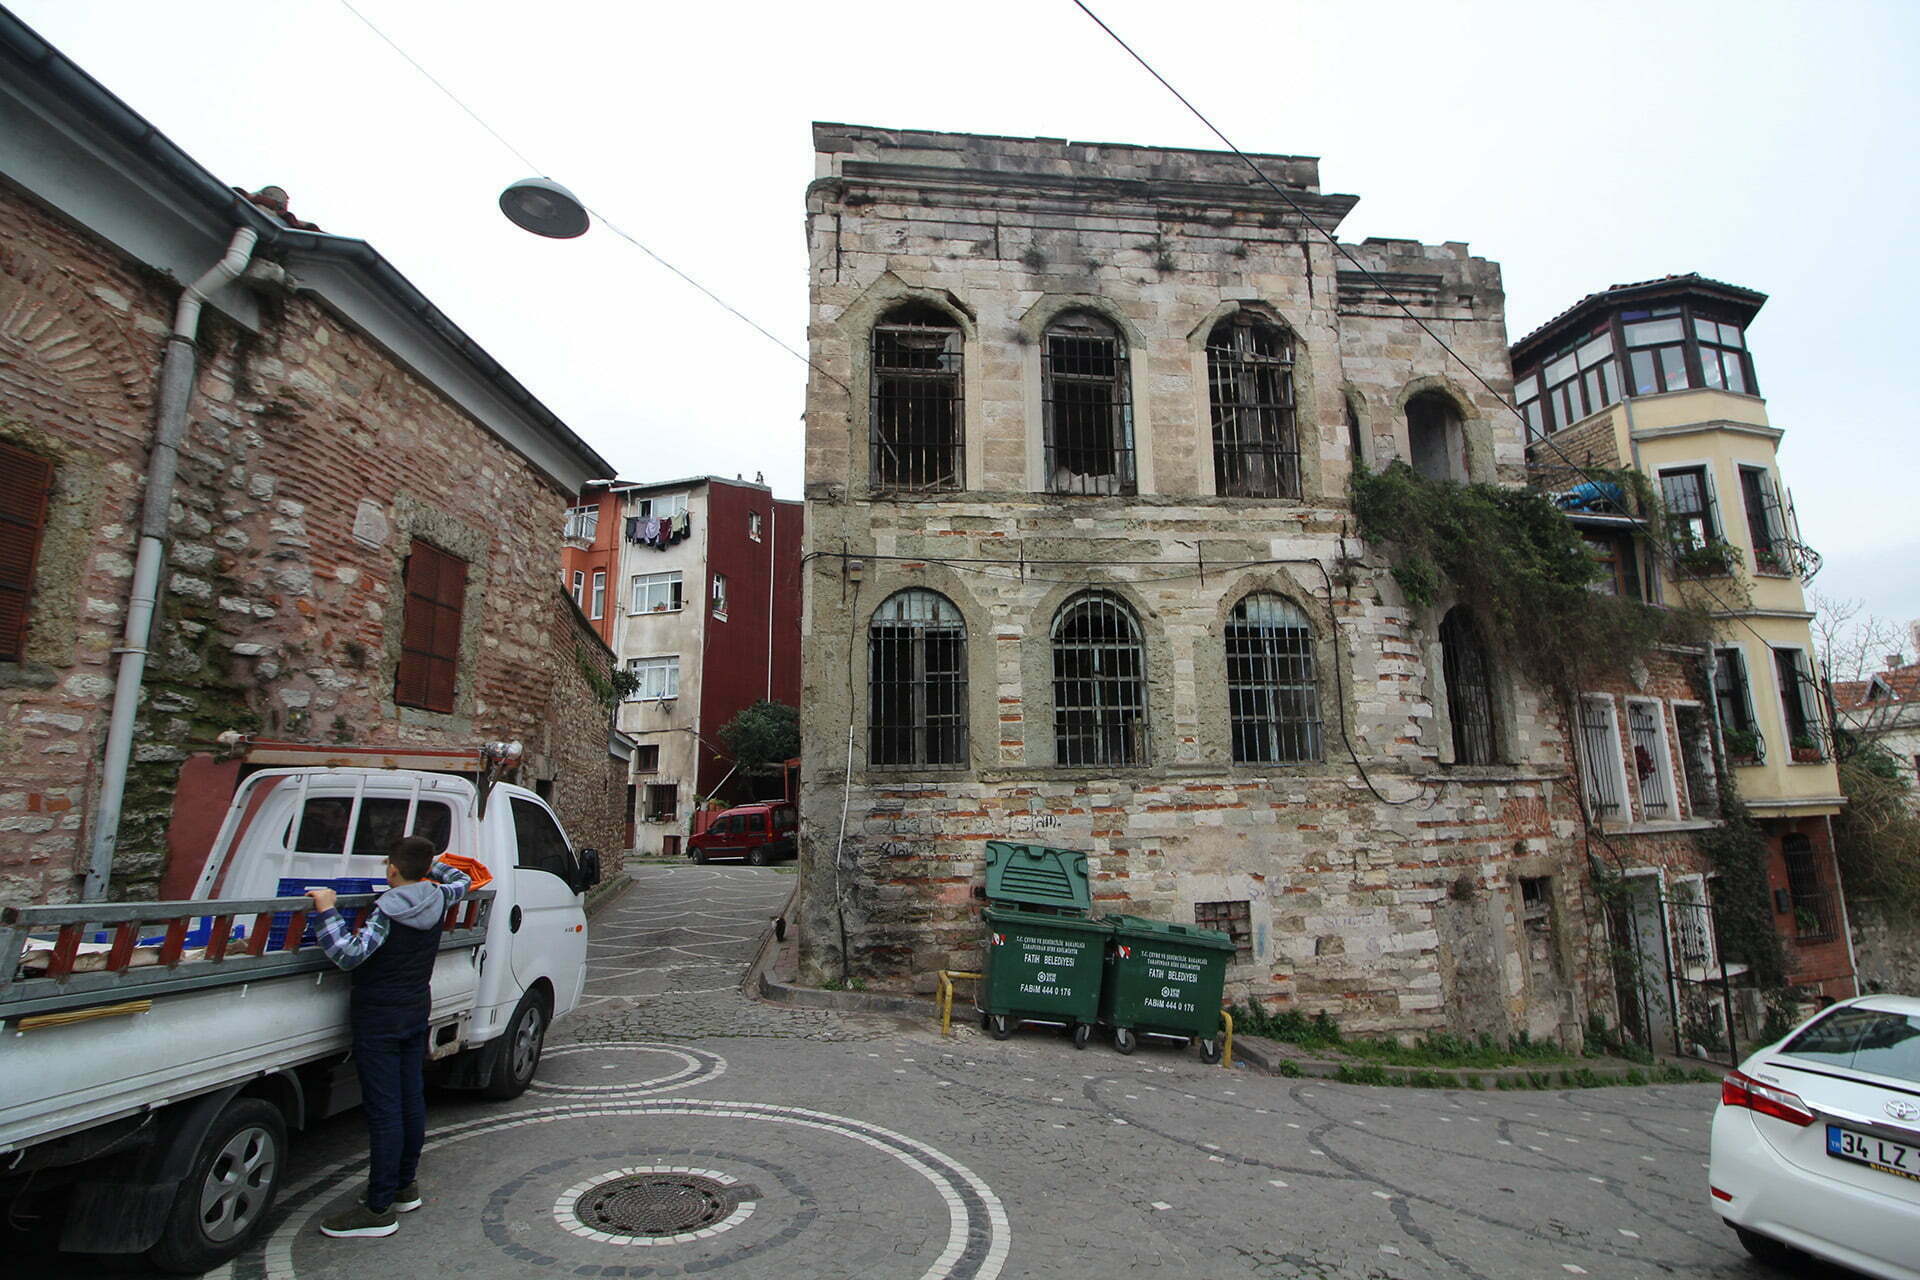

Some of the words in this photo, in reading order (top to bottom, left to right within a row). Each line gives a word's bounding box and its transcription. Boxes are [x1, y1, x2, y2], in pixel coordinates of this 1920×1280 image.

[1042, 986, 1053, 995] 444
[1054, 987, 1059, 995] 0
[1060, 988, 1071, 996] 176
[1165, 1000, 1177, 1010] 444
[1178, 1002, 1183, 1010] 0
[1184, 1003, 1195, 1012] 176
[1842, 1133, 1869, 1158] 34
[1878, 1142, 1906, 1168] LZ
